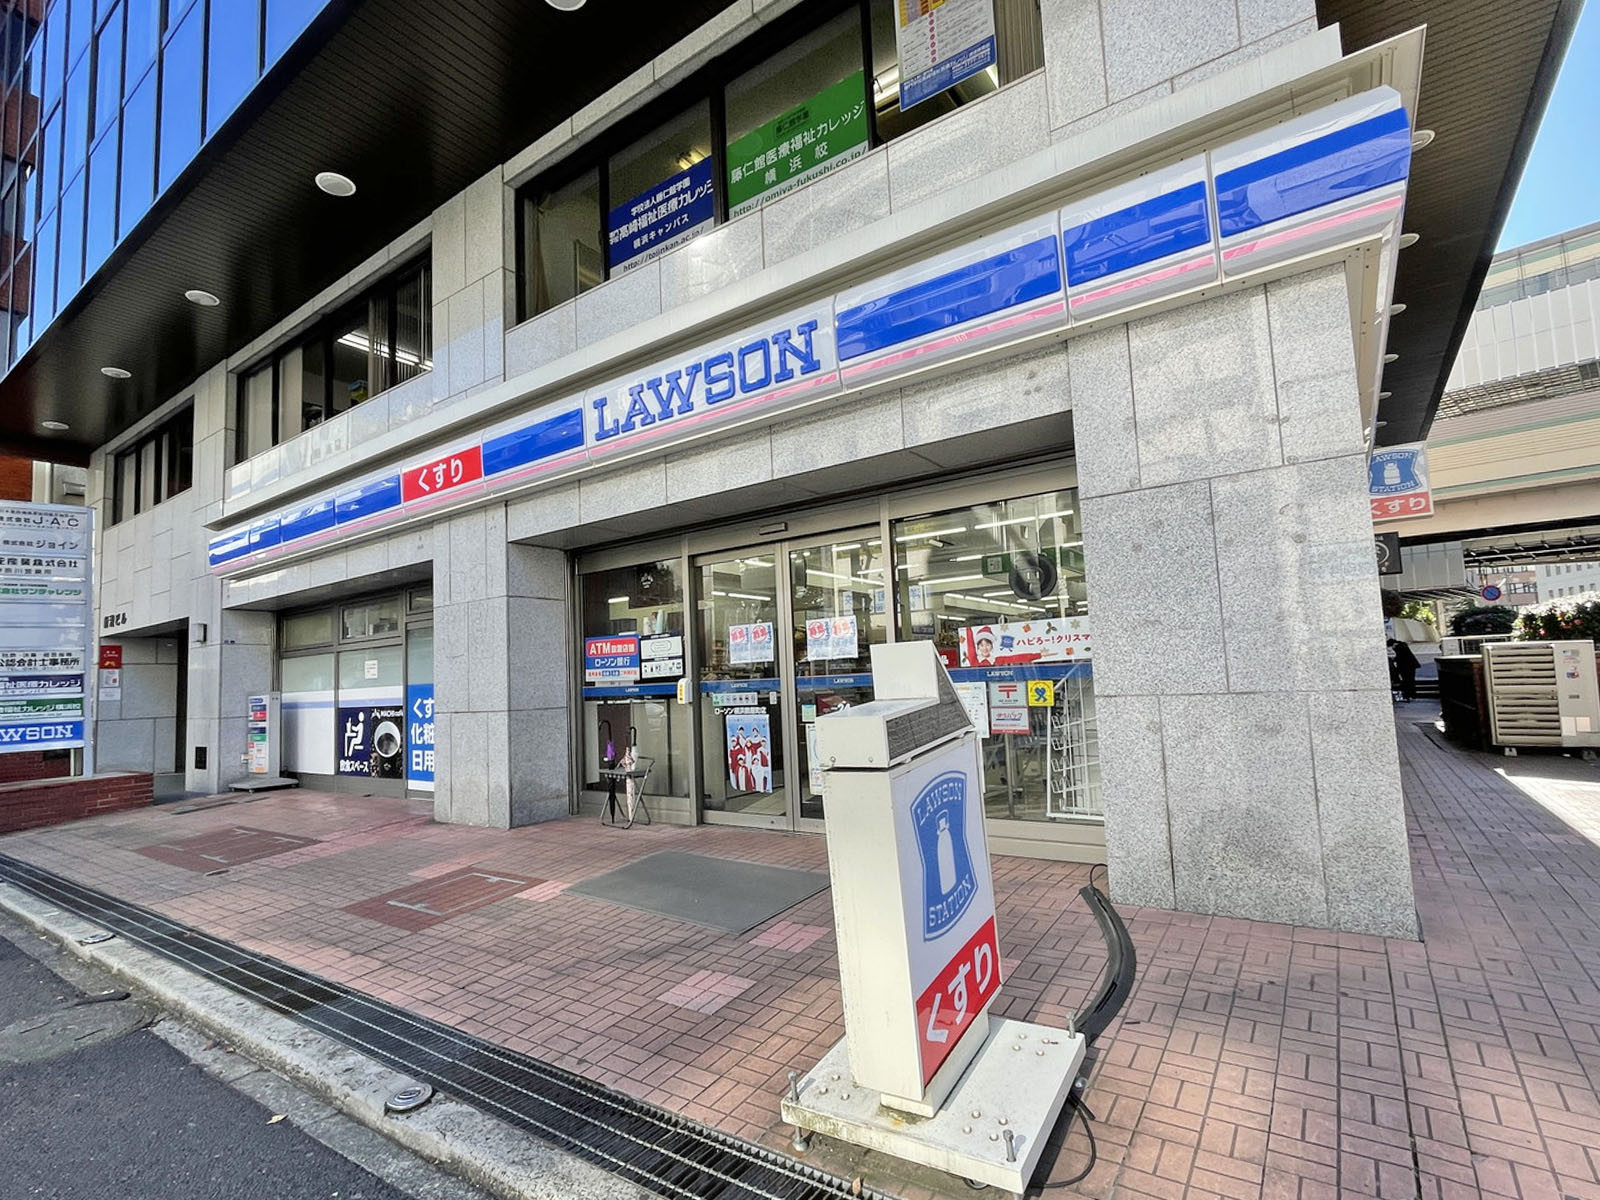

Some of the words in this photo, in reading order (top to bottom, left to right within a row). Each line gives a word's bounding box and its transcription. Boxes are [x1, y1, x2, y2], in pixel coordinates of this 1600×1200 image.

[765, 142, 828, 185] 横浜校
[593, 319, 820, 441] LAWSON
[418, 458, 463, 492] くすり
[1372, 452, 1413, 465] AWSON
[1371, 480, 1415, 493] STATION
[1371, 497, 1426, 515] くすり
[0, 725, 74, 742] WSON
[917, 782, 962, 827] LAWSON
[929, 873, 972, 927] STATION
[926, 942, 993, 1044] くすり
